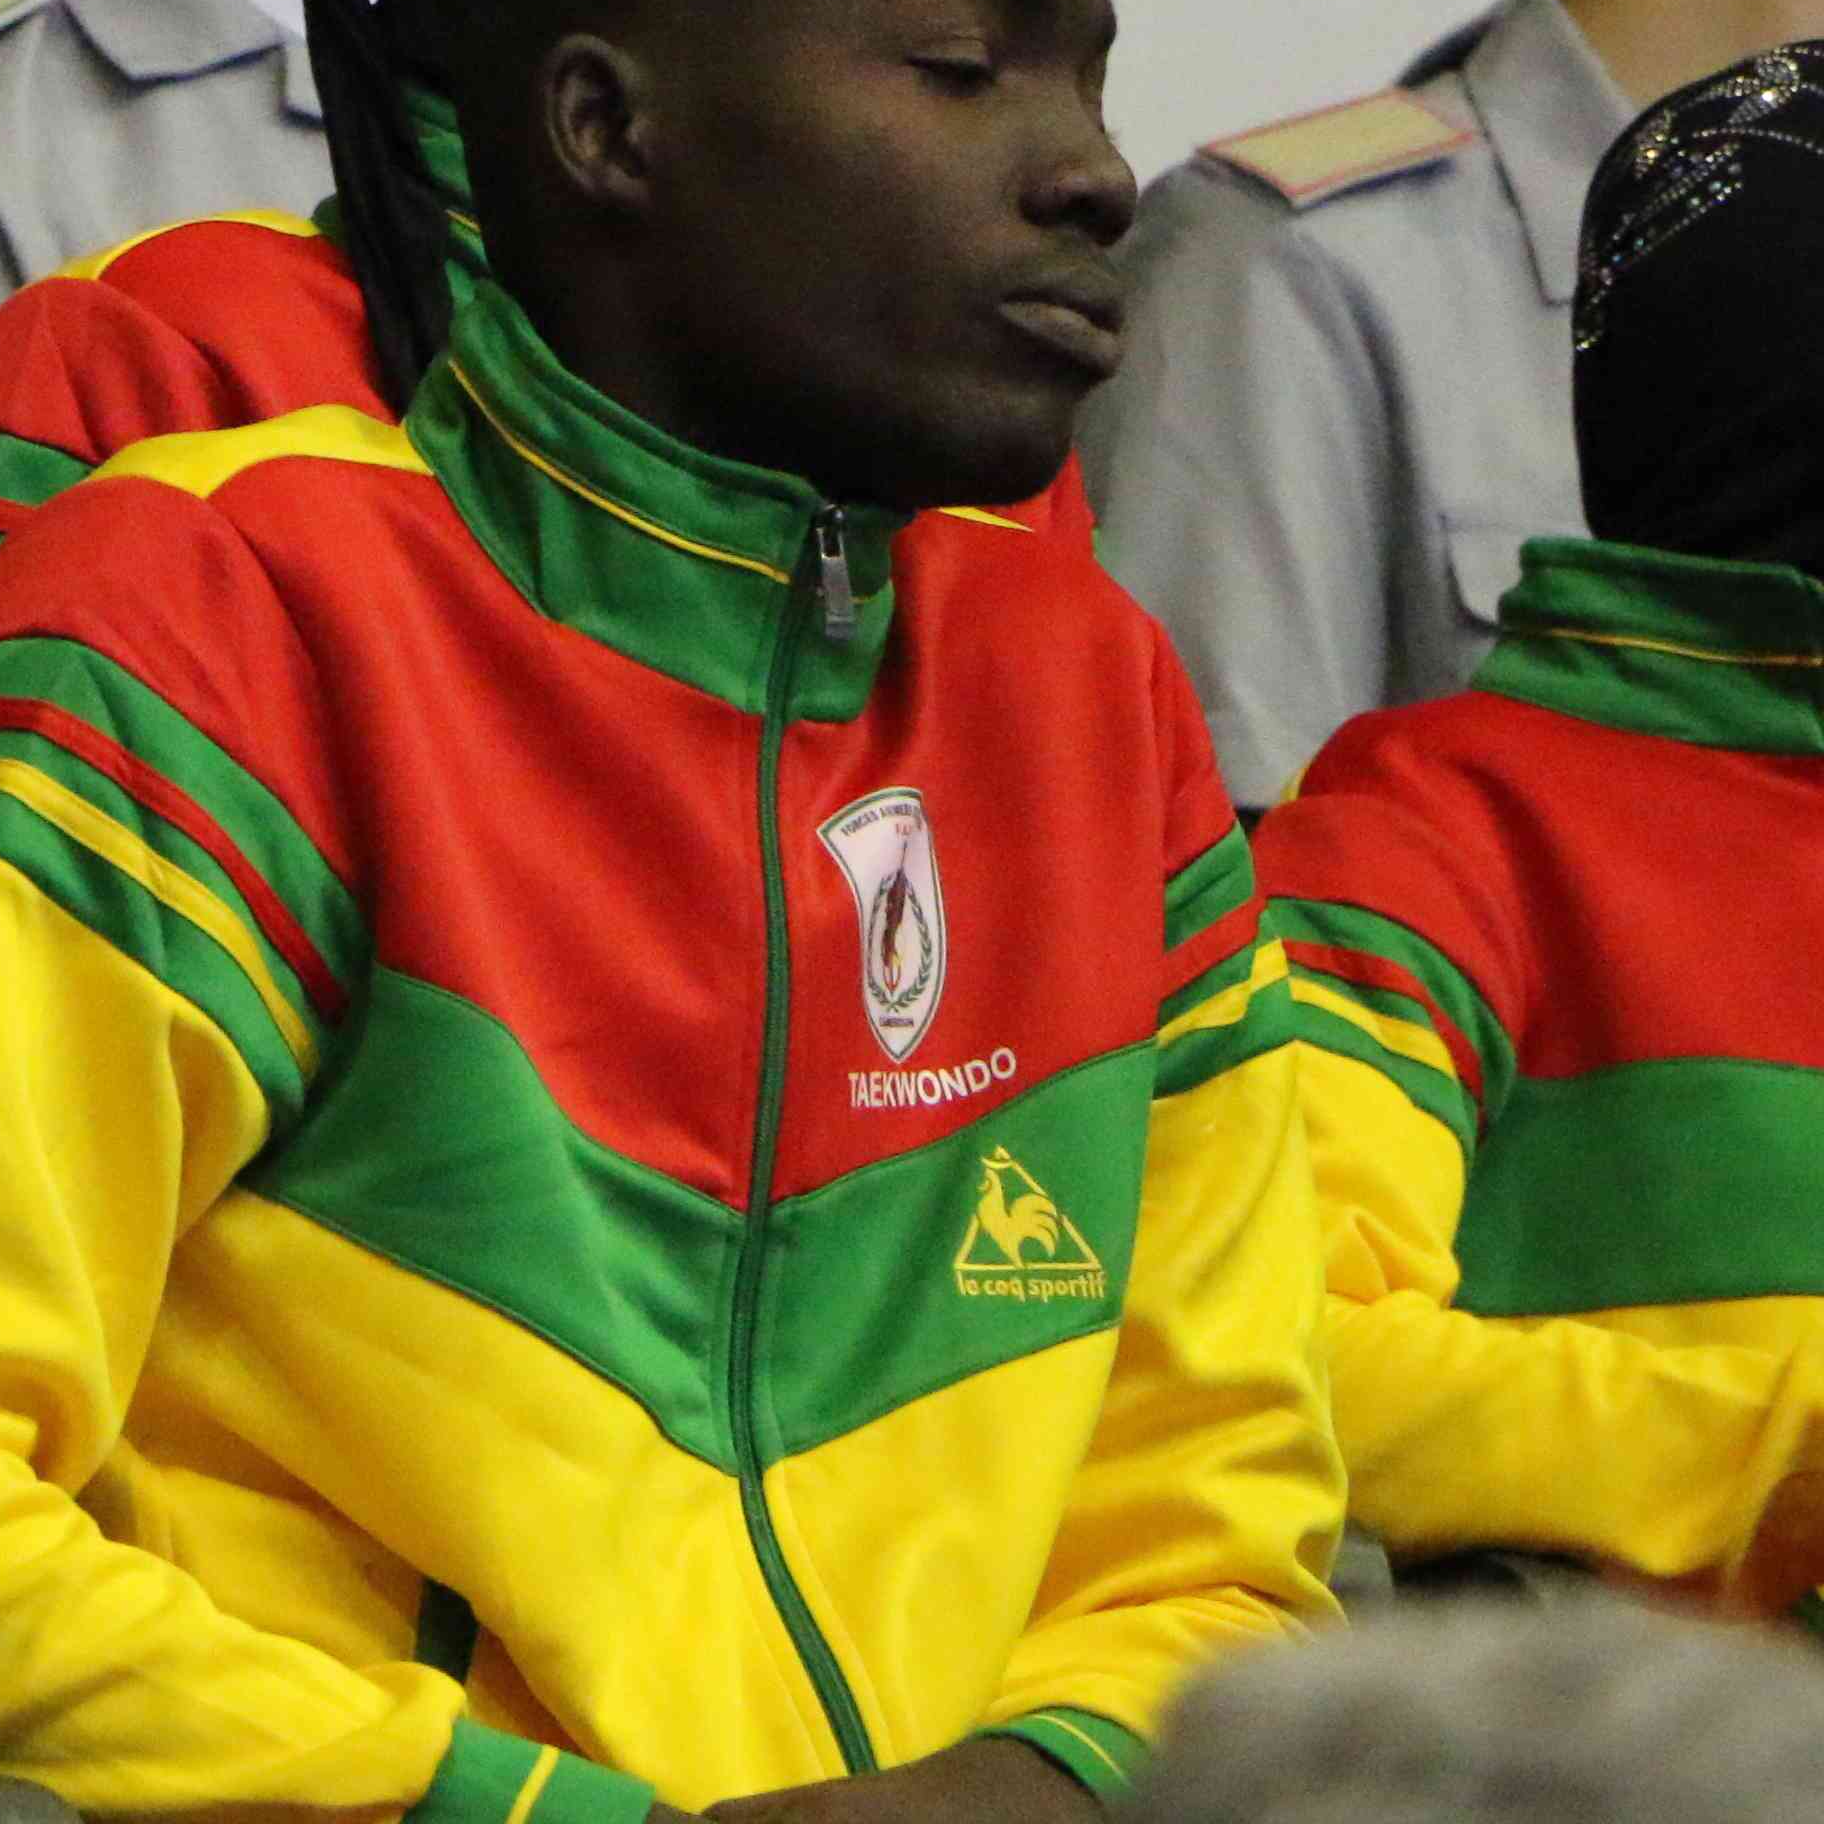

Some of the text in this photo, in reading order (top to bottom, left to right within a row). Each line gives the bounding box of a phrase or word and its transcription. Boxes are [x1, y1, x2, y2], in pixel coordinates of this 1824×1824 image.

[848, 1047, 1017, 1108] TAEKWONDO
[956, 1270, 1105, 1303] le coq sportif
